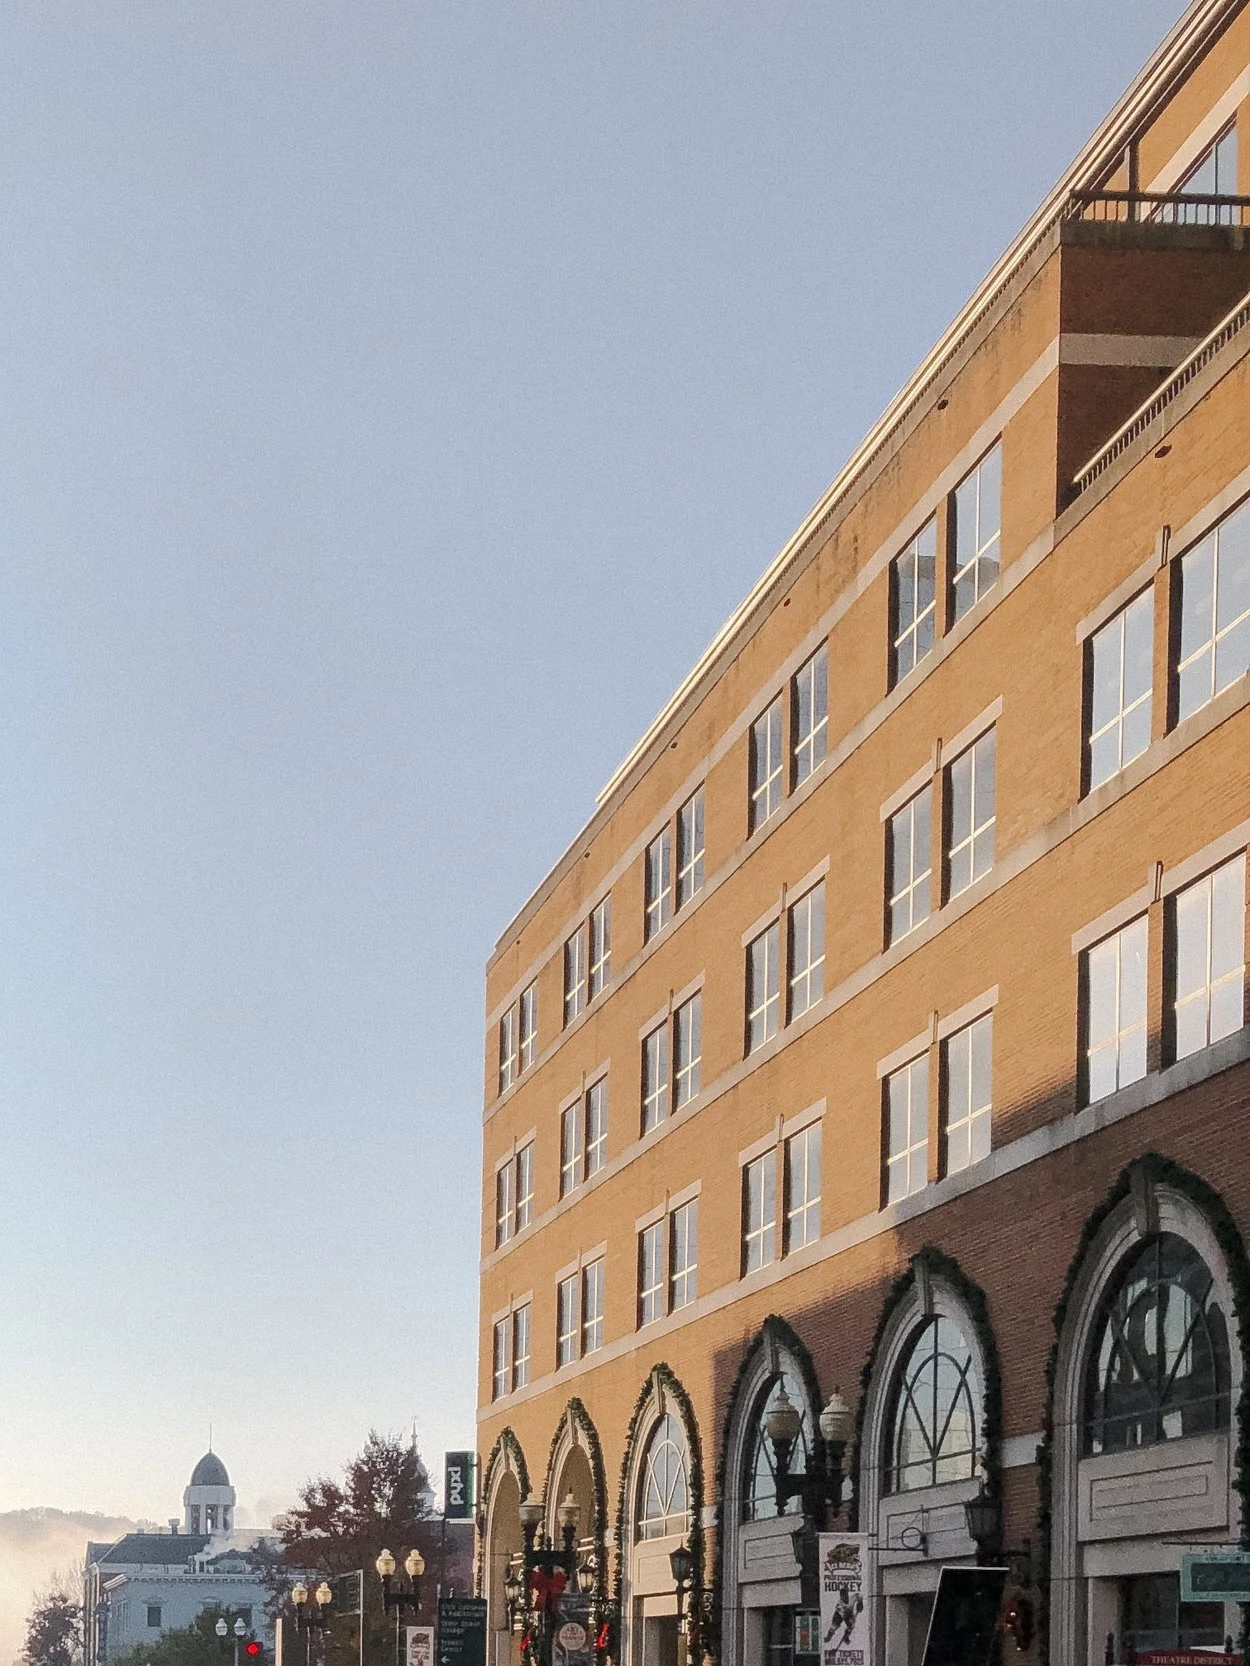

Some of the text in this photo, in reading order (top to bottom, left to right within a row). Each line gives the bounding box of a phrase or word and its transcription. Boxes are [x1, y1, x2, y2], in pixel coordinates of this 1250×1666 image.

[824, 1581, 863, 1592] HOCKEY
[1150, 1655, 1236, 1666] THEATRE DISTRICT
